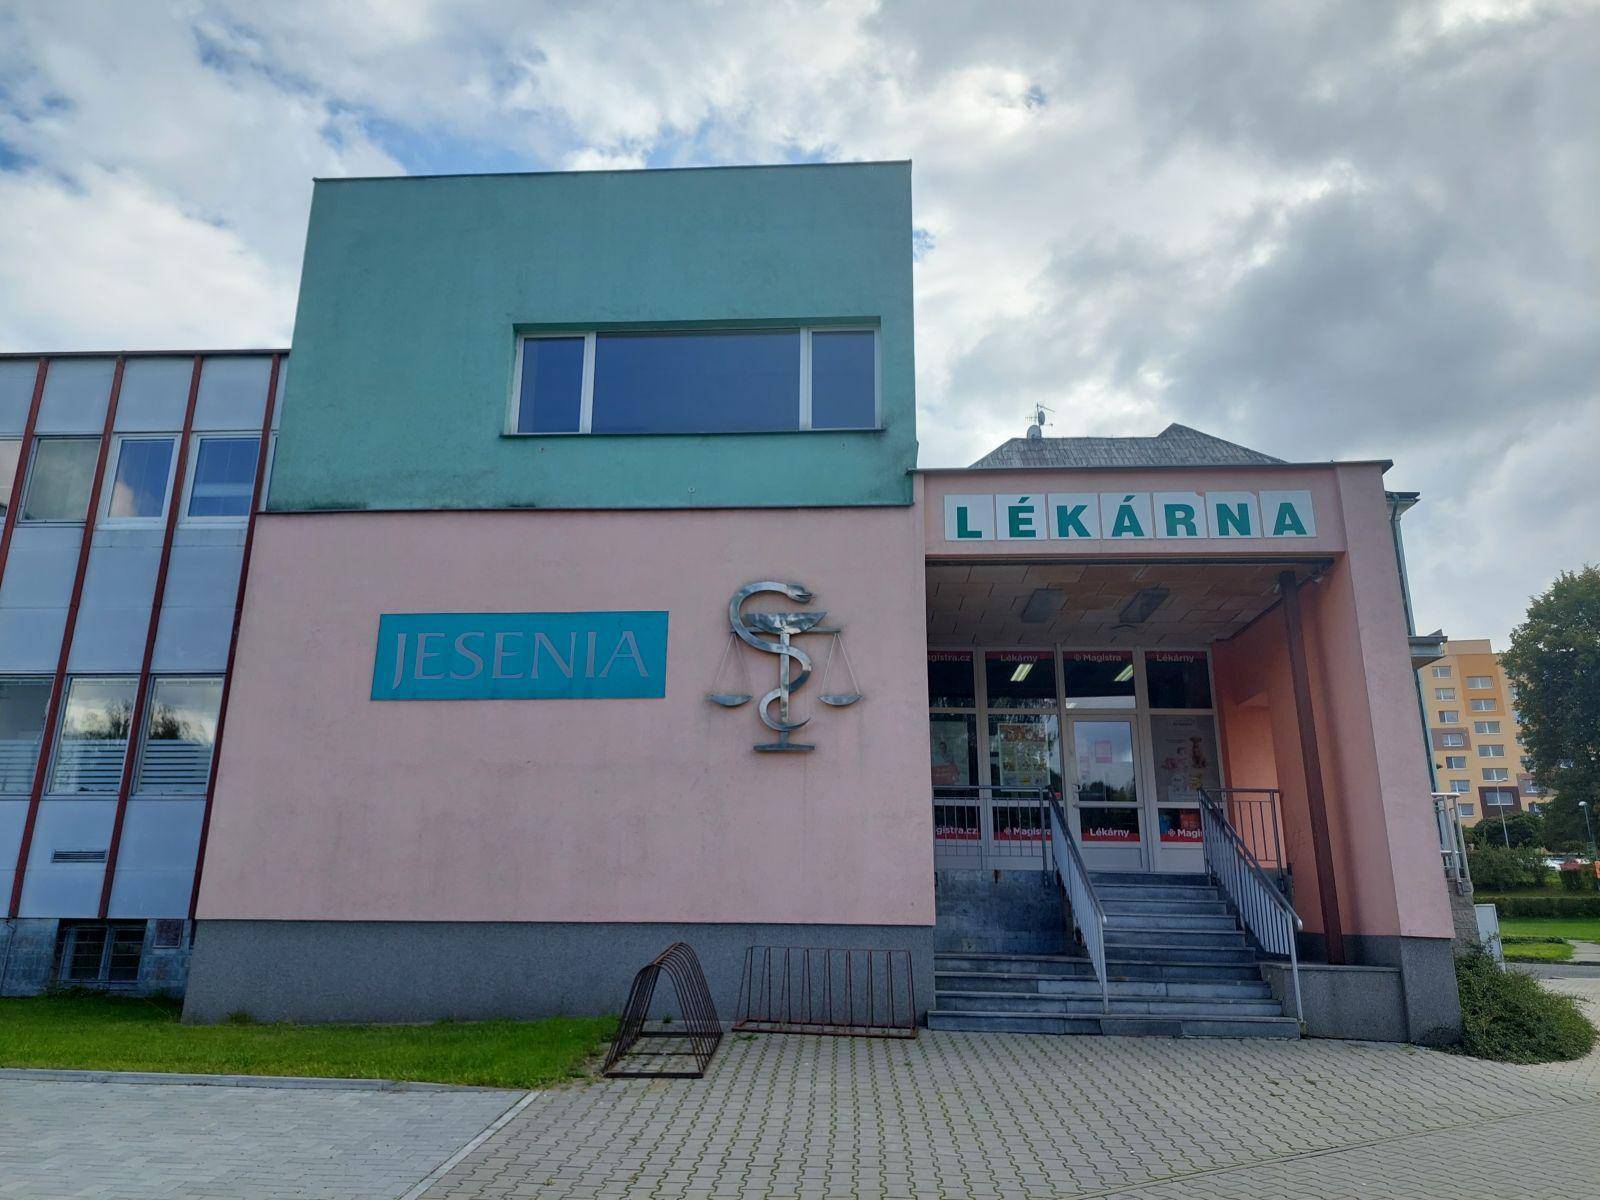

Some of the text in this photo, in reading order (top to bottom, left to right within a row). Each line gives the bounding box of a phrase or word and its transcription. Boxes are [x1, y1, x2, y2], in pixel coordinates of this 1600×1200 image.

[956, 495, 1307, 539] LÉKÁRNA
[392, 630, 649, 690] JESENIA
[1083, 654, 1122, 664] Magistra
[1156, 653, 1195, 664] Lékárny
[1089, 826, 1130, 838] Lékárny
[1177, 827, 1203, 839] Magi
